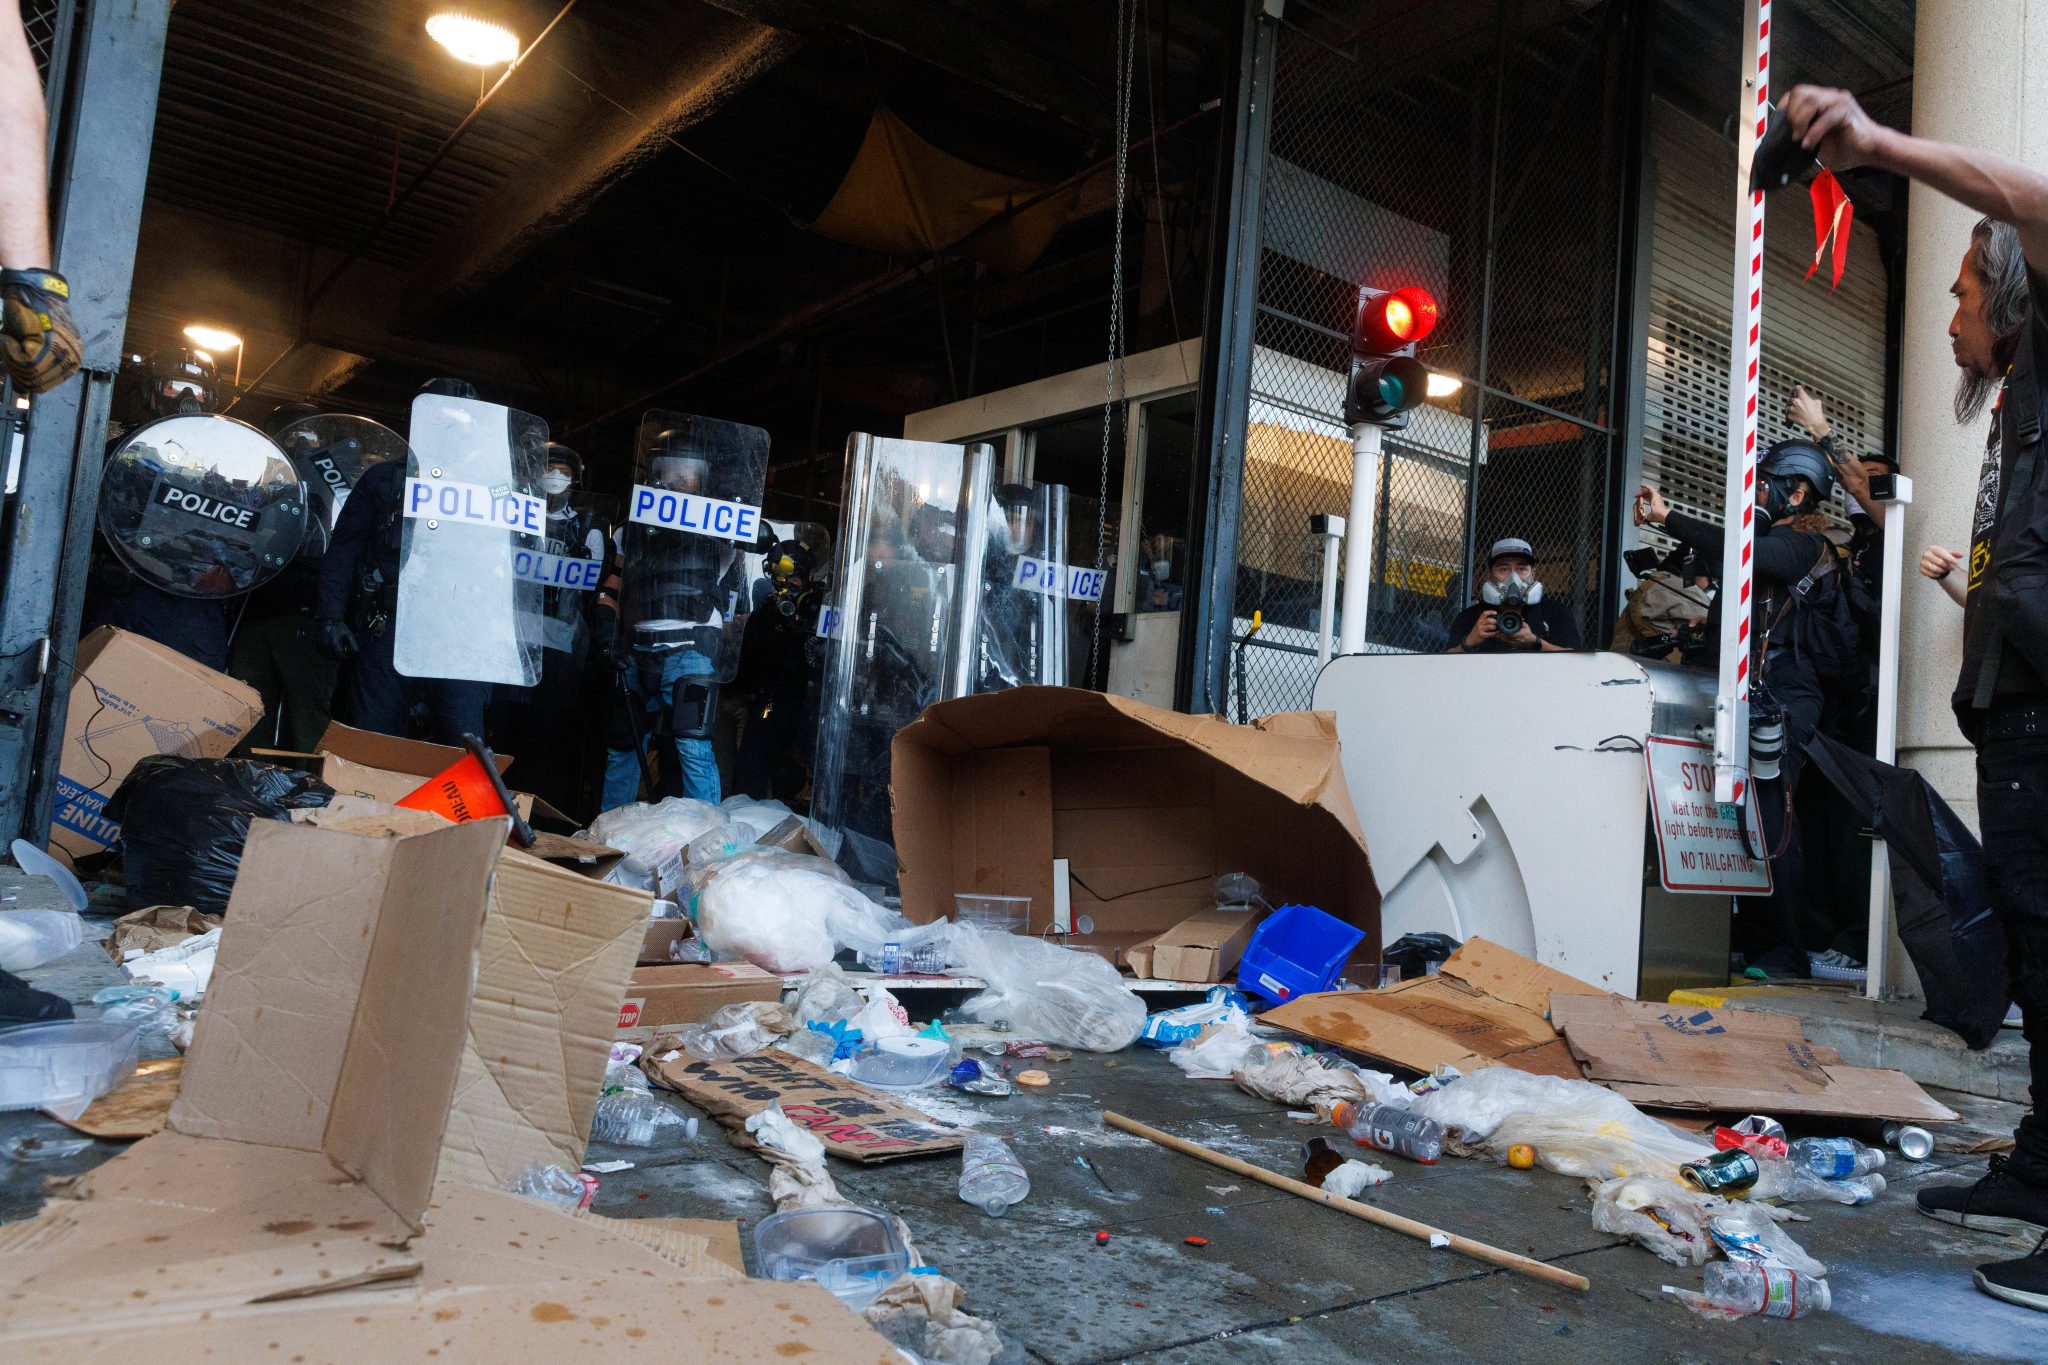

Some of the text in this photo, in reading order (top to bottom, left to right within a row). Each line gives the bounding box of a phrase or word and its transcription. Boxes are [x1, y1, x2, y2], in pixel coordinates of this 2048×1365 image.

[314, 458, 348, 494] POL
[163, 487, 254, 528] POLICE
[411, 483, 540, 531] POLICE
[636, 490, 756, 538] POLICE
[514, 552, 602, 588] OLICE
[1019, 561, 1104, 597] POICE
[1681, 762, 1716, 793] STO
[57, 781, 108, 813] MAILERS
[1671, 800, 1737, 820] Wait for the GRE
[59, 803, 121, 843] ULINE
[1664, 819, 1758, 846] light before proceeng
[1680, 851, 1753, 873] NO TAILGATING
